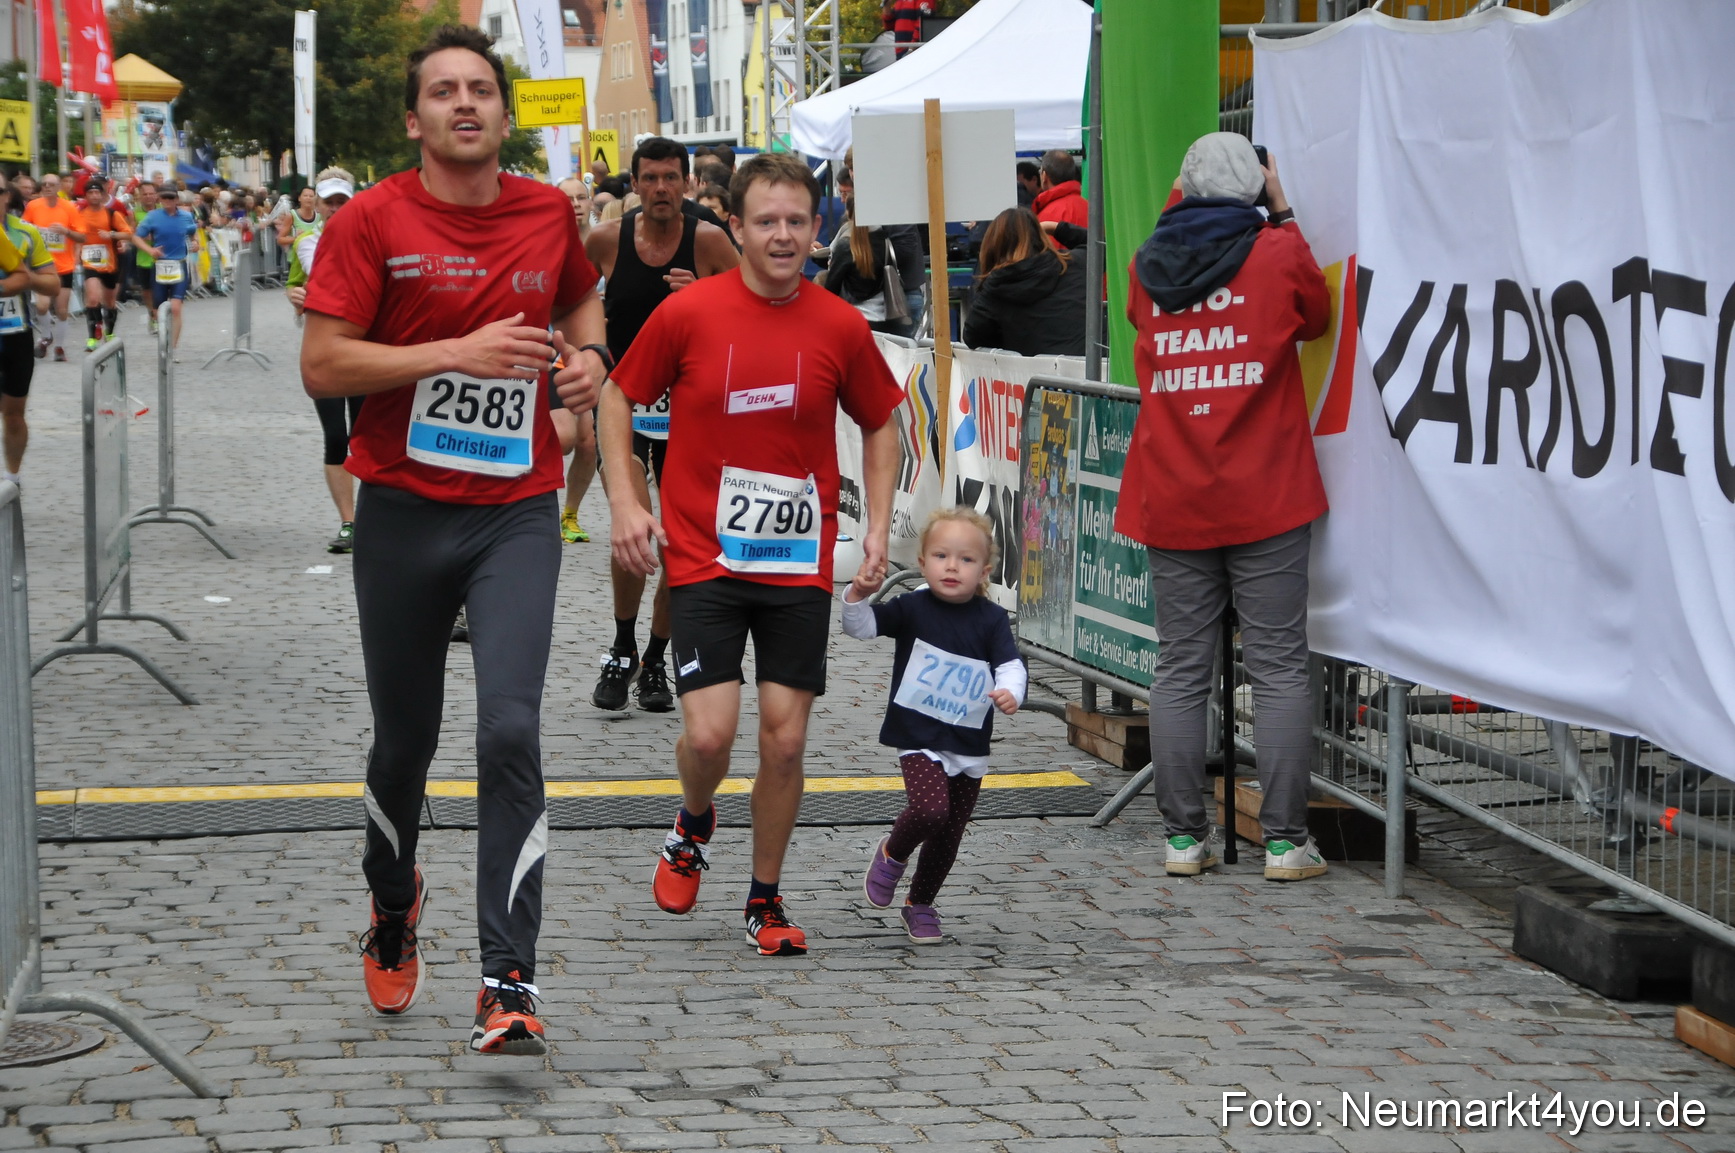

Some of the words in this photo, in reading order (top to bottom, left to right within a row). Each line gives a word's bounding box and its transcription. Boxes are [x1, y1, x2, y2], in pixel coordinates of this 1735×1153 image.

[519, 93, 580, 105] Schnupper-
[541, 104, 561, 115] lauf
[0, 119, 20, 146] A
[1154, 326, 1248, 356] TEAM-
[1150, 362, 1264, 393] MUELLER
[426, 378, 526, 431] 2583
[747, 393, 777, 405] DEHN
[1189, 403, 1210, 416] .DE
[435, 432, 507, 459] Christian
[723, 476, 760, 491] PARTL
[727, 494, 814, 534] 2790
[1082, 499, 1110, 539] Mehr
[740, 542, 792, 558] Thomas
[1080, 550, 1097, 591] für
[1100, 556, 1112, 597] Ihr
[1114, 563, 1149, 609] Event!
[1077, 627, 1093, 654] Miet
[1093, 632, 1099, 656] &
[1100, 634, 1122, 664] Service
[1122, 641, 1139, 669] Line:
[921, 694, 968, 717] ANNA
